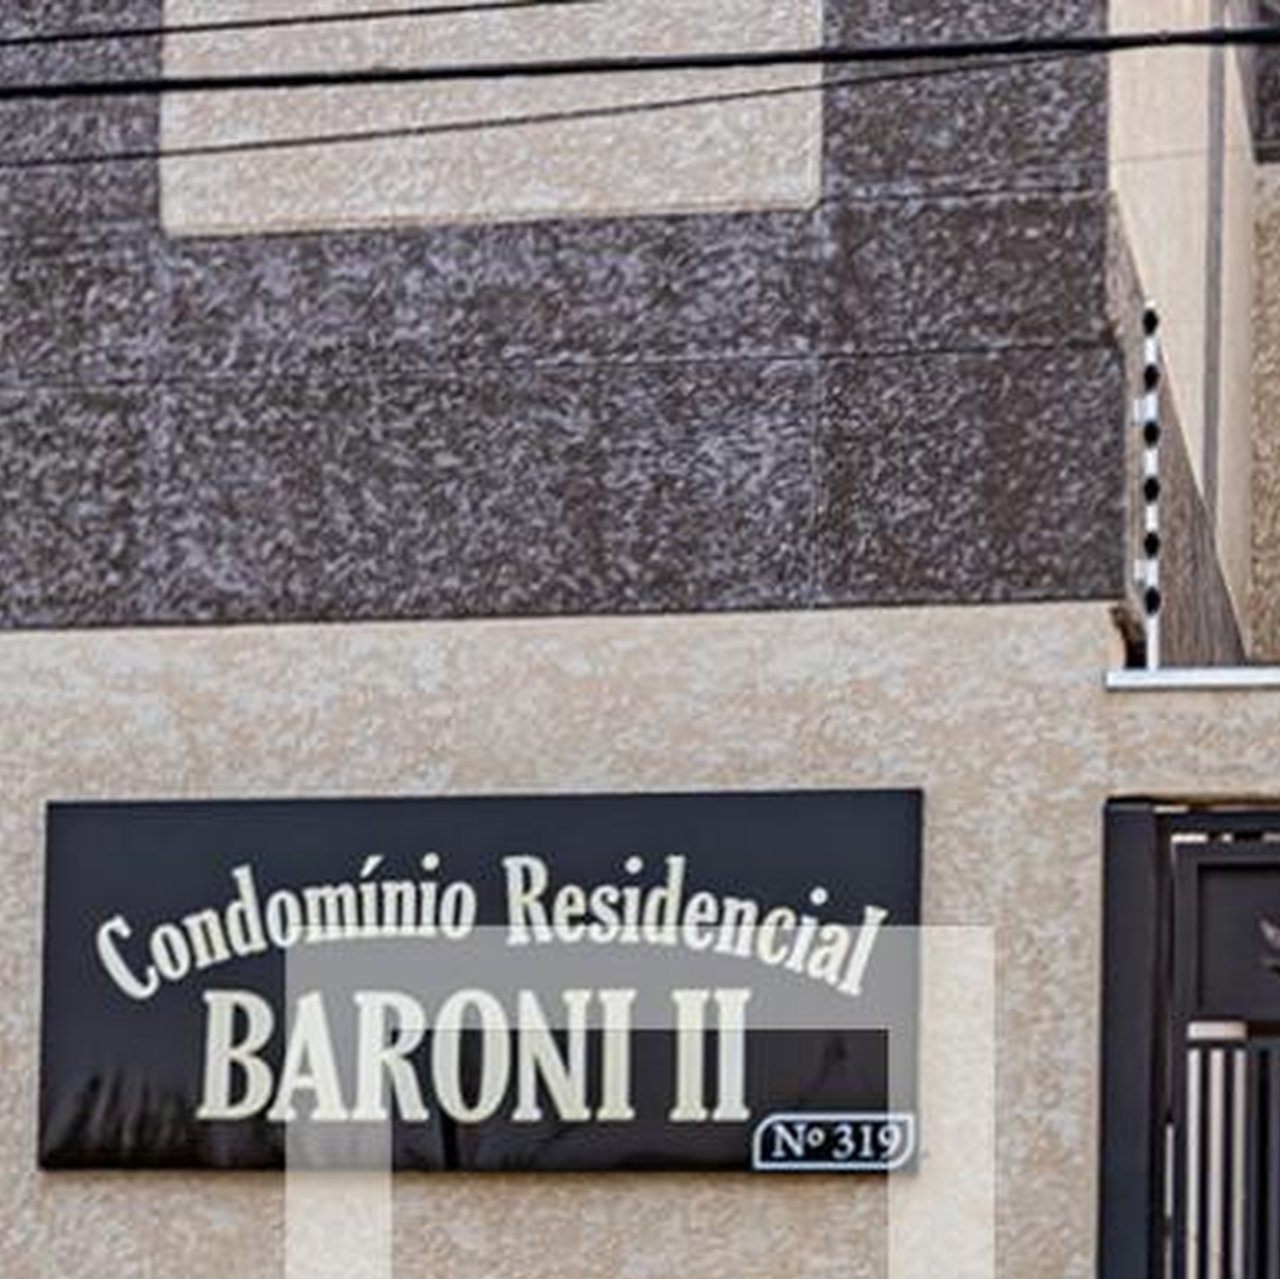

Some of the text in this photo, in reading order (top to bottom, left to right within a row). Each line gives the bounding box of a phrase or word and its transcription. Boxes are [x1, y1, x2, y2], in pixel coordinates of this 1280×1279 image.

[96, 852, 889, 1000] Condomínio Residencial
[195, 987, 752, 1123] BARONI II
[831, 1123, 902, 1160] 319
